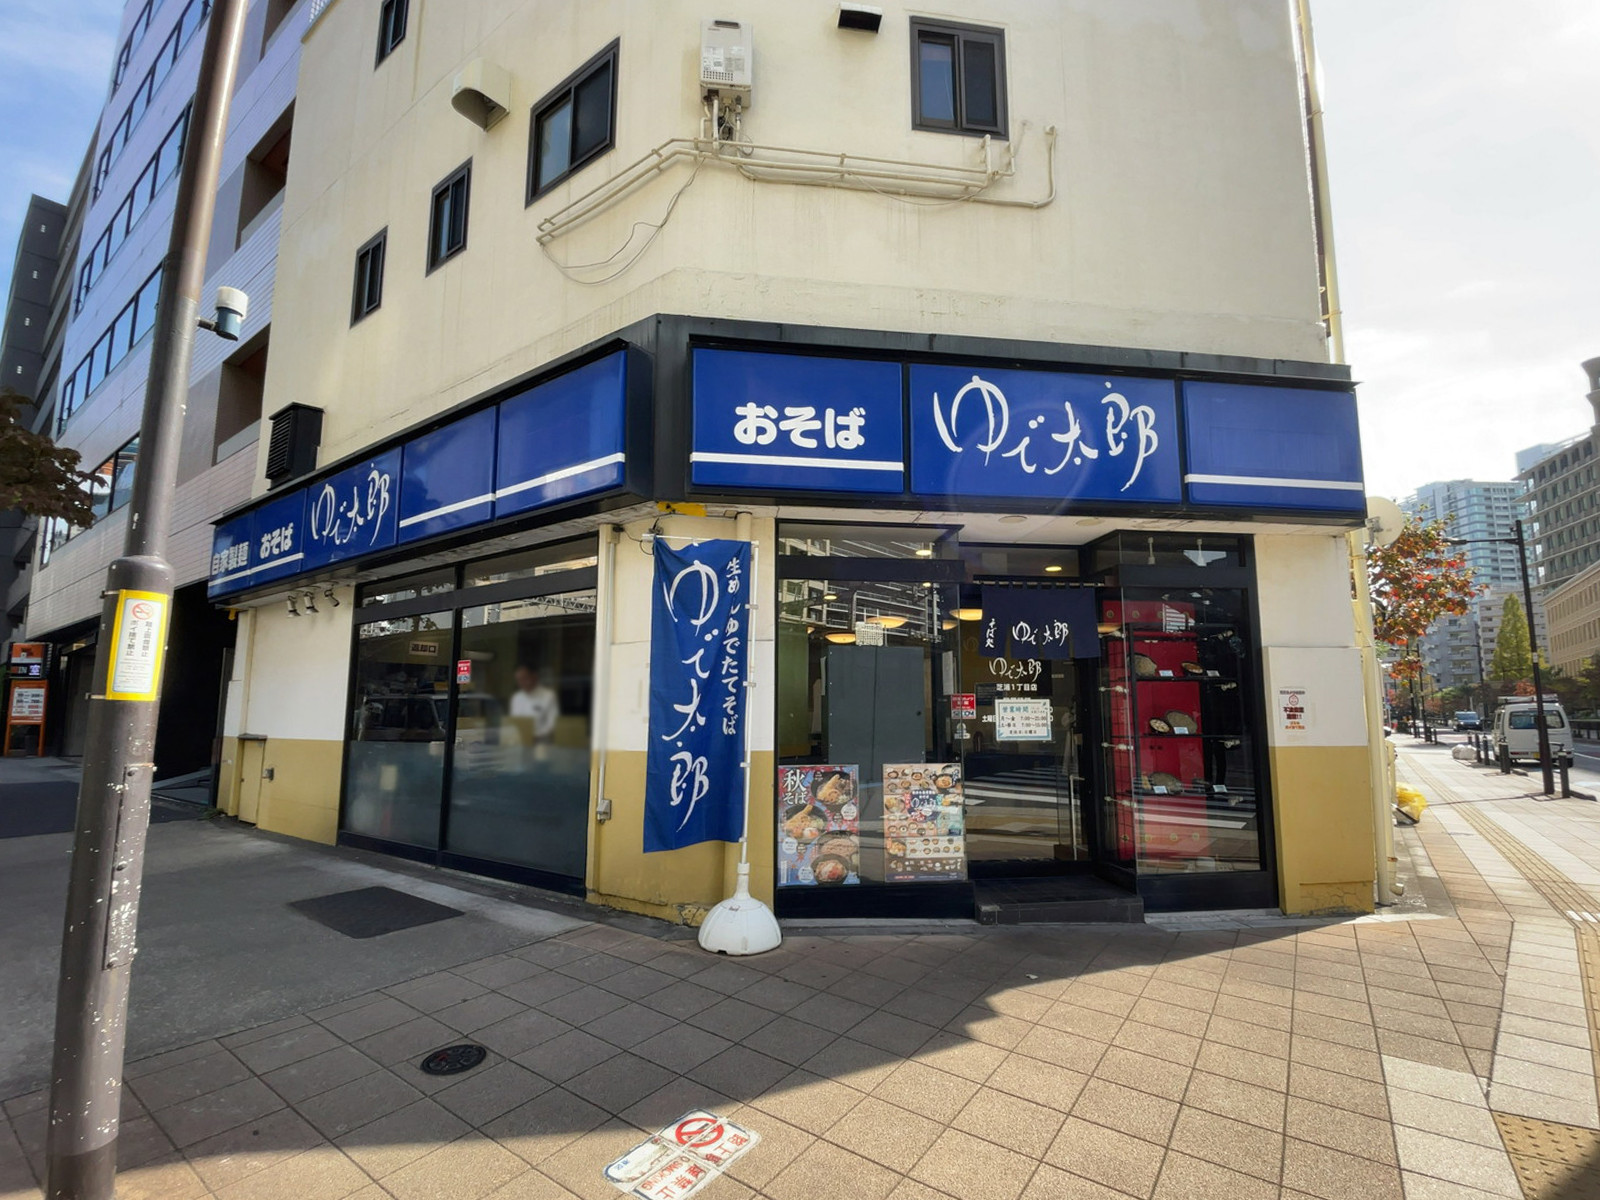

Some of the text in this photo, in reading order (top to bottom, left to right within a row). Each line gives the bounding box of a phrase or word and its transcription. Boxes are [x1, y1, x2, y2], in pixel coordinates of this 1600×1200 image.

[733, 401, 866, 449] おそば
[932, 375, 1159, 492] ゆで太郎
[311, 462, 390, 546] ゆで太郎
[212, 541, 249, 576] 自家製麺
[260, 522, 294, 559] おそば
[1012, 619, 1069, 646] ゆで太郎
[989, 657, 1042, 682] ゆで太郎
[662, 559, 719, 832] ゆで太郎
[782, 769, 807, 792] 秋
[782, 792, 807, 805] そば
